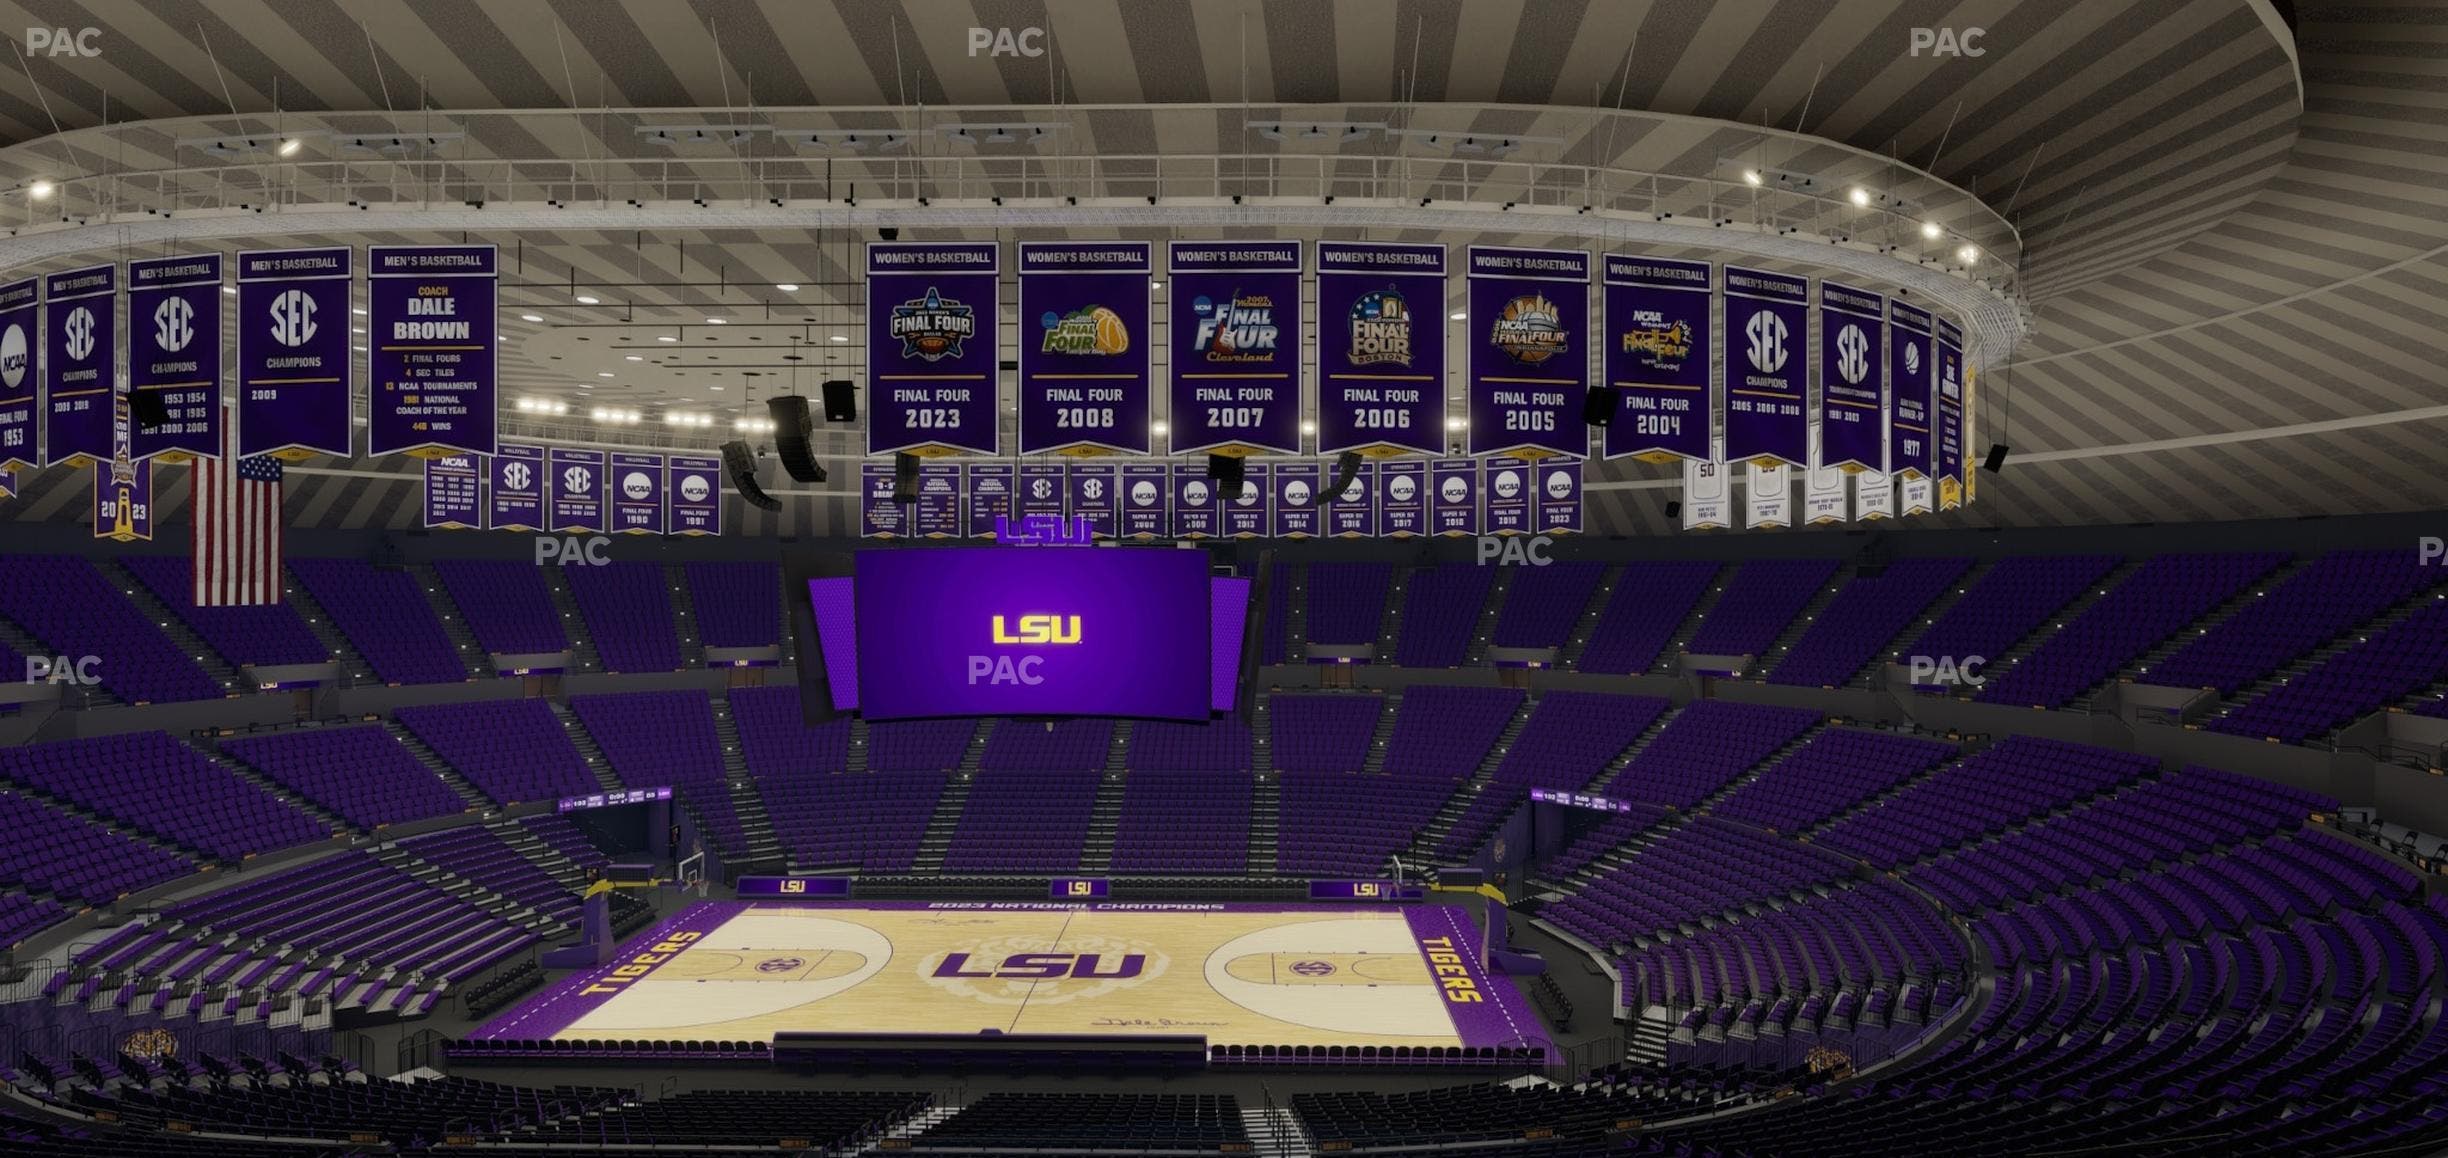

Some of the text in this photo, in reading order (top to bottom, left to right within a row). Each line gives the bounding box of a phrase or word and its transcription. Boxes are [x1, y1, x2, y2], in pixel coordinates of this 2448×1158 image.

[384, 256, 482, 266] MEN'S BASKETBALL
[875, 252, 990, 264] WOMEN'S BASKETBALL
[1028, 252, 1144, 263] WOMEN'S BASKETBALL
[1177, 251, 1293, 262] WOMEN'S BASKETBALL
[1325, 252, 1439, 265] WOMEN'S BASKETBALL
[252, 258, 338, 271] MEN'S BASKETBALL
[1476, 256, 1583, 272] WOMEN'S BASKETBALL
[139, 264, 211, 280] MEN'S BASKETBALL
[1610, 264, 1706, 281] WOMEN'S BASKETBALL
[73, 275, 108, 288] BASKETBALL
[1729, 275, 1804, 295] WOMEN'S BASKETBALL
[418, 286, 448, 296] COACH
[408, 298, 455, 316] DALE
[270, 289, 318, 347] SEC
[1633, 310, 1662, 322] NCAA
[154, 296, 194, 352] SEC
[394, 322, 470, 340] BROWN
[893, 316, 971, 334] FINAL FOUR
[1060, 321, 1095, 335] FINAL
[1353, 320, 1408, 338] FINAL
[1500, 320, 1528, 330] NCAA
[65, 307, 95, 360] SEC
[1042, 330, 1094, 351] FOUR
[1498, 334, 1534, 344] FINAL
[1532, 332, 1566, 342] FOUR
[1353, 338, 1408, 354] FOUR
[1746, 310, 1789, 373] SEC
[1206, 351, 1274, 362] Cleveland
[1358, 354, 1402, 363] BOSTON
[1837, 324, 1868, 384] SEC
[152, 361, 197, 374] CHAMPIONS
[266, 357, 322, 368] CHAMPIONS
[63, 370, 98, 382] CHAMPIONS
[1746, 376, 1788, 390] CHAMPIONS
[399, 382, 478, 390] NCAA TOURNAMENTS
[165, 392, 206, 405] 1953 1954
[252, 390, 277, 400] 2009
[424, 396, 460, 404] NATIONAL
[894, 390, 970, 402] FINAL FOUR
[1046, 389, 1123, 402] FINAL FOUR
[1196, 388, 1274, 400] FINAL FOUR
[1344, 388, 1419, 403] FINAL FOUR
[1494, 392, 1565, 406] FINAL FOUR
[396, 406, 467, 415] COACH OF THE YEAR
[1626, 396, 1690, 411] FINAL FOUR
[1732, 400, 1752, 412] 2005
[1756, 402, 1776, 414] 2006
[906, 409, 960, 428] 2023
[1057, 408, 1114, 428] 2008
[1208, 408, 1264, 427] 2007
[1354, 408, 1410, 428] 2006
[1506, 410, 1555, 431] 2005
[161, 422, 208, 434] 2000 2006
[1638, 415, 1680, 436] 2004
[4, 428, 23, 447] 1953
[1904, 439, 1920, 457] 1977
[440, 457, 468, 467] NCAA
[503, 462, 531, 490] SEC
[1700, 464, 1714, 478] 50
[564, 466, 591, 494] SEC
[626, 484, 650, 492] NCAA
[1032, 478, 1052, 499] SEC
[1083, 478, 1103, 499] SEC
[1134, 492, 1156, 500] NCAA
[992, 615, 1082, 644] LSU
[780, 880, 806, 893] LSU
[1068, 882, 1092, 895] LSU
[1354, 882, 1379, 896] LSU
[579, 930, 702, 996] TIGERS
[931, 952, 1146, 978] LSU
[1422, 936, 1484, 1004] TIGERS
